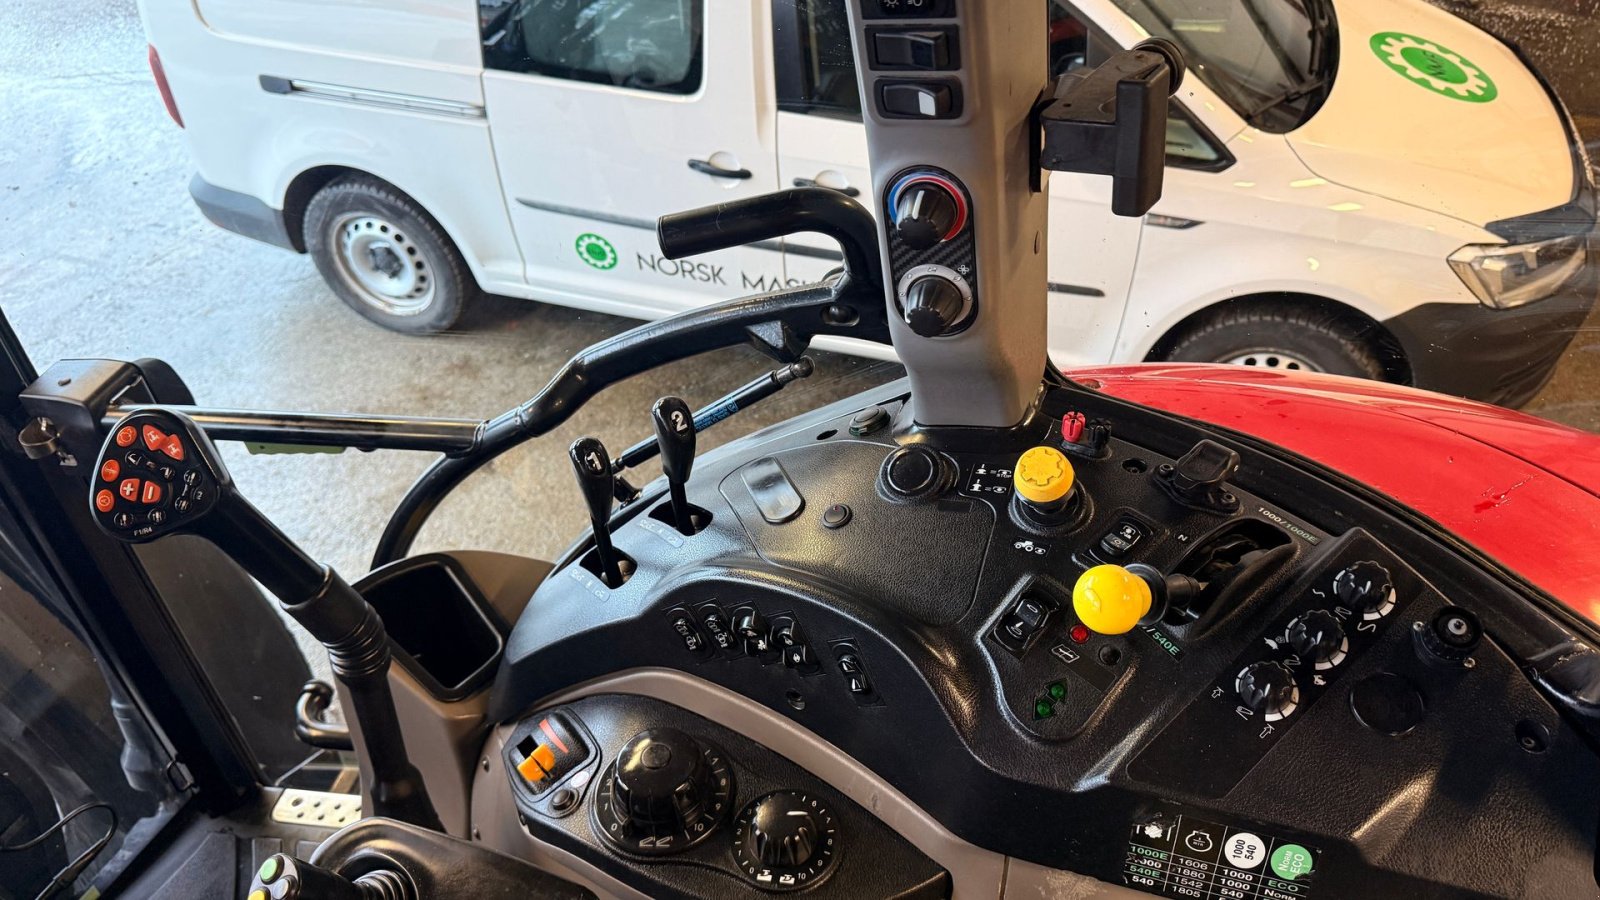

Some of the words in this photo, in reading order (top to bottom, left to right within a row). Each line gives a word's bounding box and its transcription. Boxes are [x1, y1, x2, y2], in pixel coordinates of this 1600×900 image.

[636, 252, 727, 286] NORSK
[670, 410, 688, 432] 2
[586, 451, 602, 471] 1
[1258, 506, 1318, 544] 1000/1000E
[1177, 533, 1188, 542] N
[610, 823, 618, 831] 0
[694, 823, 704, 831] 10
[1130, 846, 1169, 860] 1000E
[1232, 839, 1246, 859] 1000
[1245, 845, 1257, 860] 540
[1134, 857, 1162, 869] 000
[1179, 858, 1208, 870] 1606
[1290, 853, 1304, 874] ECO
[1129, 865, 1160, 878] 540E
[1177, 867, 1206, 879] 1880
[1222, 869, 1253, 881] 1000
[1132, 875, 1154, 886] 540
[1174, 876, 1204, 889] 1542
[1220, 878, 1250, 890] 1000
[1268, 880, 1299, 892] ECO
[1172, 886, 1201, 898] 1805
[1220, 888, 1244, 899] 540
